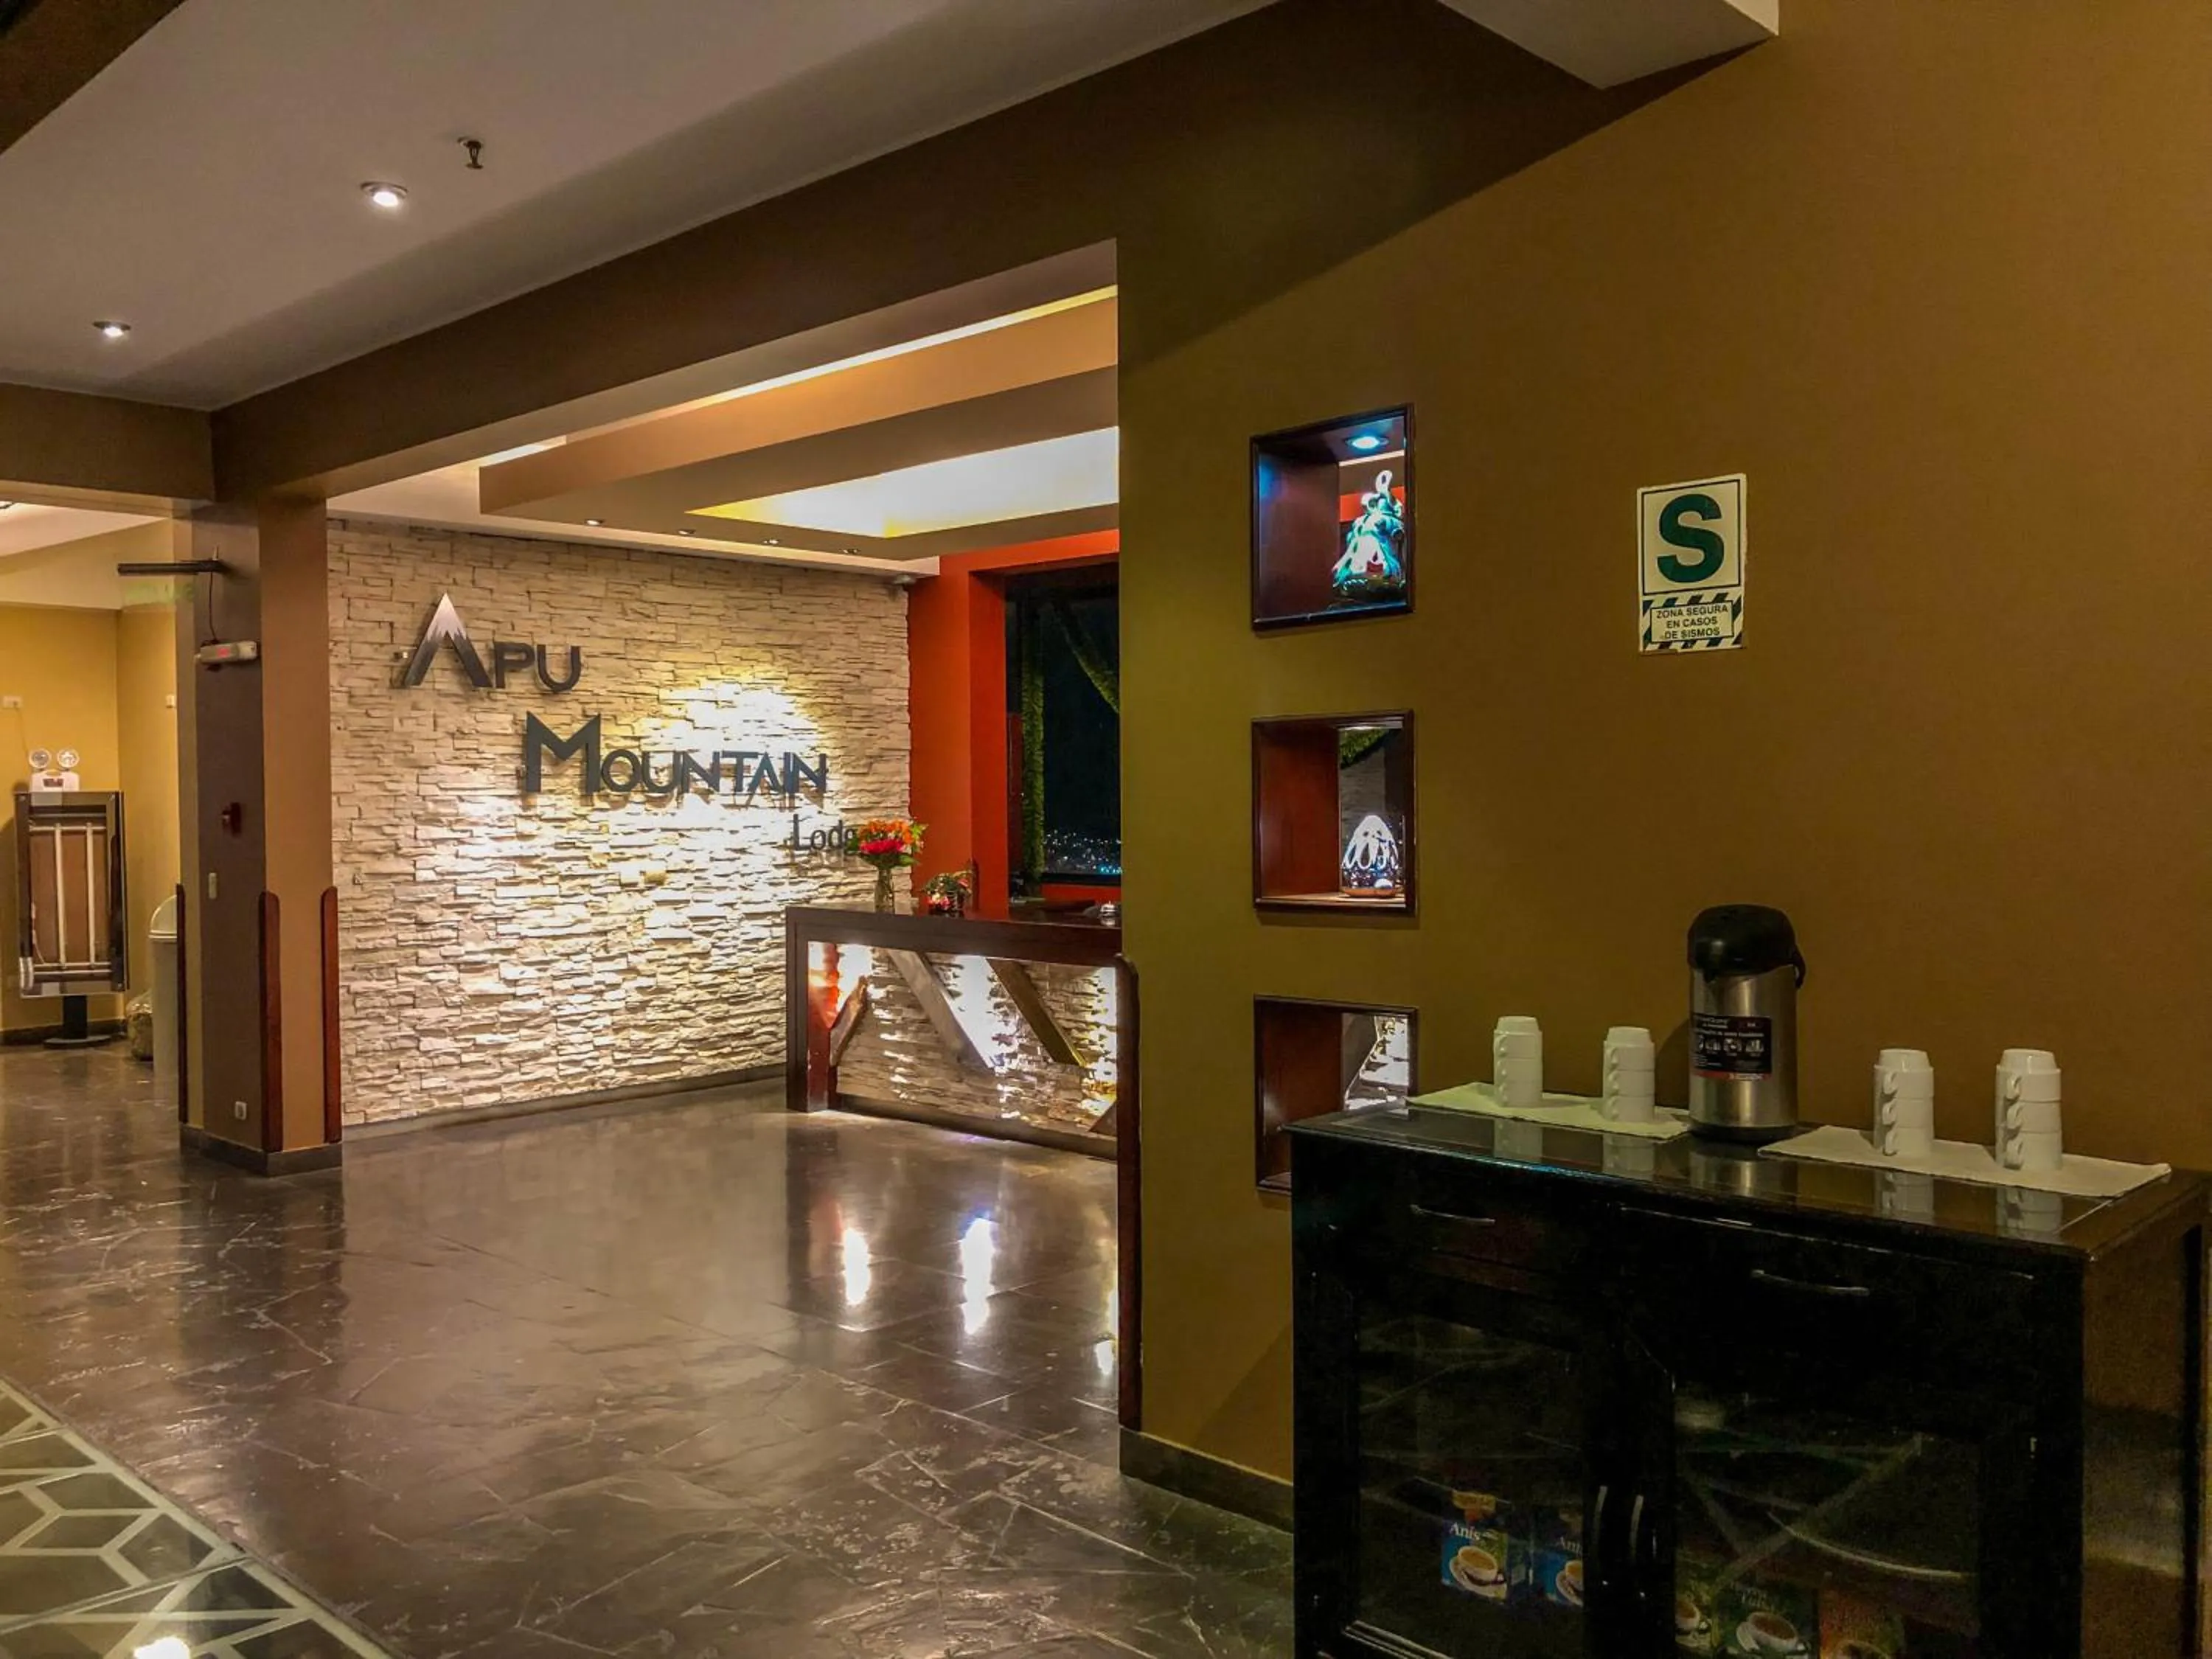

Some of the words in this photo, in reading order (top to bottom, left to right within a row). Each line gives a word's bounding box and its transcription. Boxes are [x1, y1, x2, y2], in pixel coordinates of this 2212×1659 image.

[1657, 493, 1724, 582] S
[1657, 608, 1683, 619] ZONA
[1686, 605, 1728, 616] SEGURA
[1666, 620, 1680, 628] EN
[1683, 616, 1718, 627] CASOS
[1664, 630, 1678, 639] DE
[1681, 627, 1719, 639] SISMOS
[405, 592, 581, 693] APU
